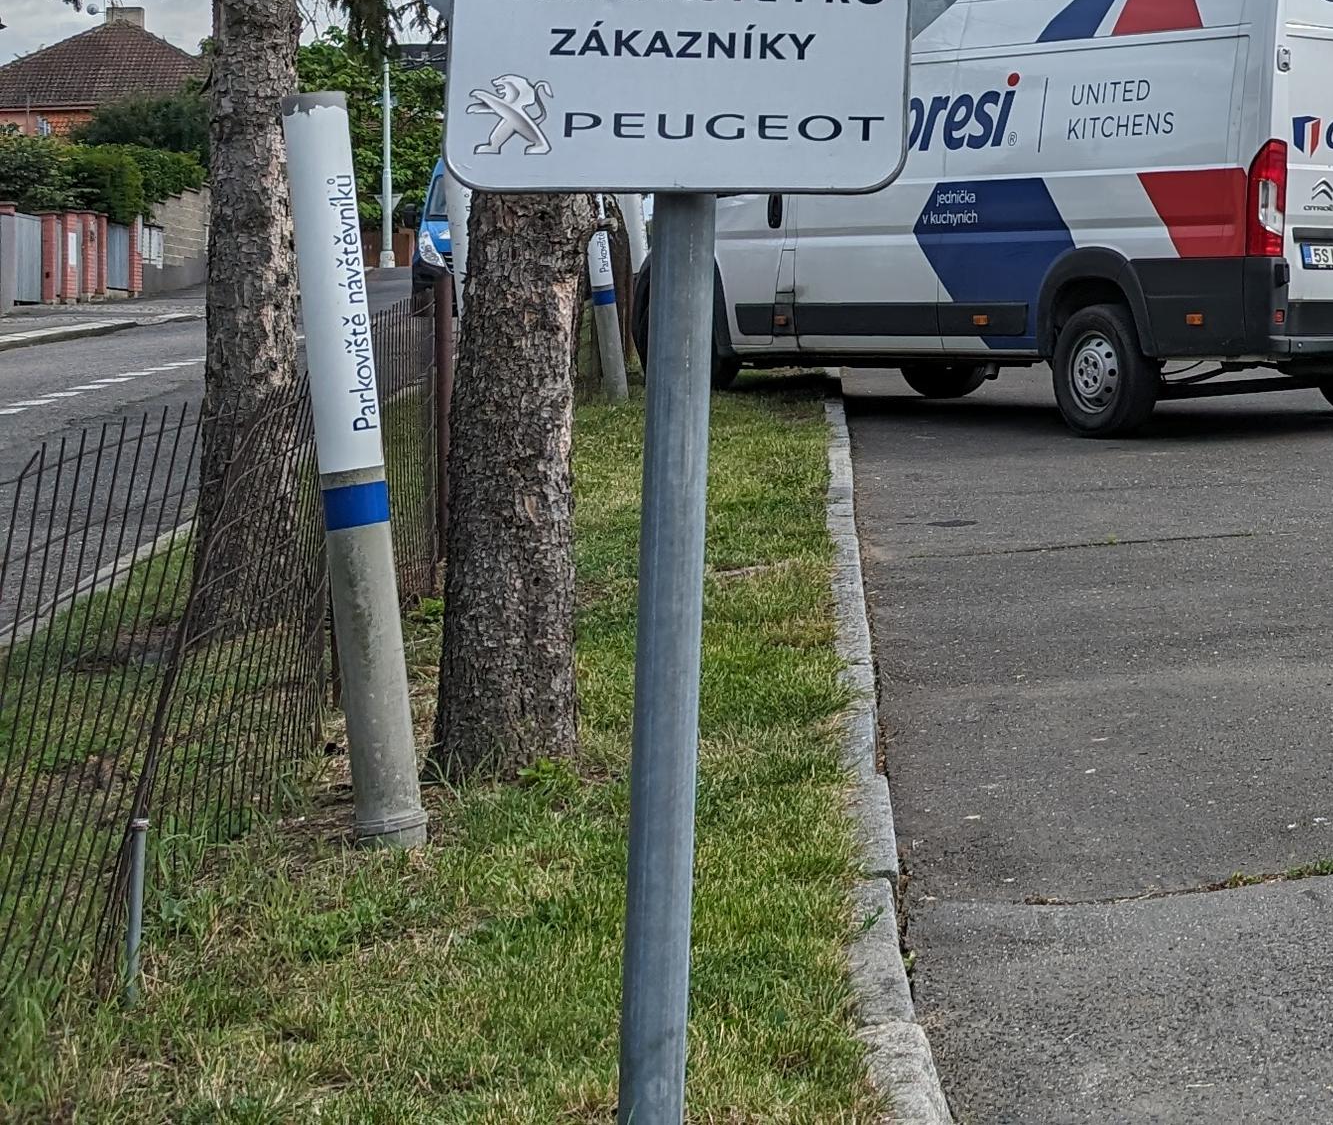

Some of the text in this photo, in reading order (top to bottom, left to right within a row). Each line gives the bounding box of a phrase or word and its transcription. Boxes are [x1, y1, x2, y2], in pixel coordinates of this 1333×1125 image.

[549, 20, 816, 61] ZÁKAZNÍKY
[1071, 79, 1151, 106] UNITED
[563, 112, 885, 143] PEUGEOT
[1067, 111, 1174, 140] KITCHENS
[936, 189, 976, 207] jednička
[930, 209, 978, 227] kuchyních
[326, 174, 378, 432] Parkoviště návštěvníků
